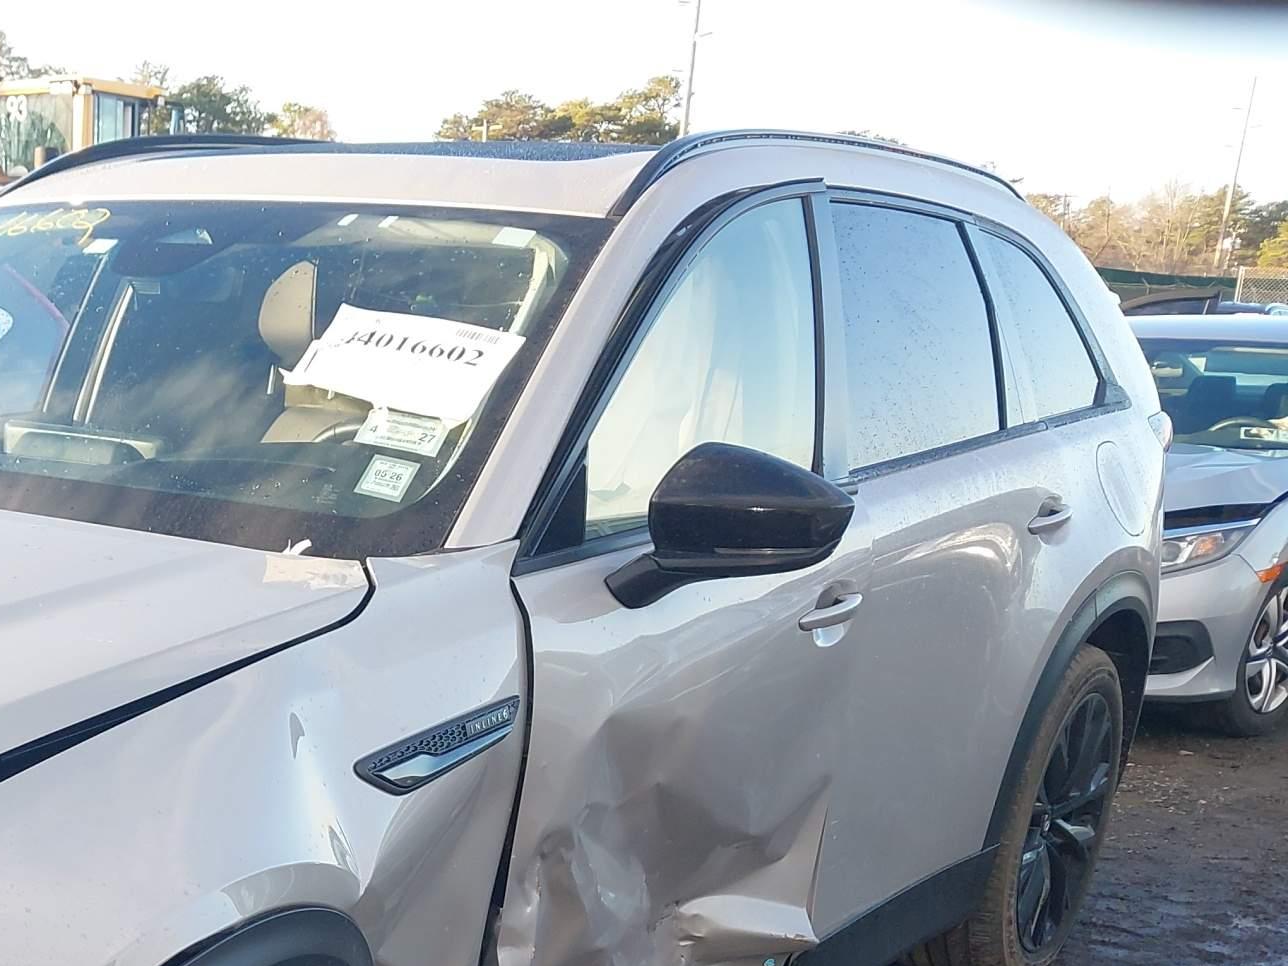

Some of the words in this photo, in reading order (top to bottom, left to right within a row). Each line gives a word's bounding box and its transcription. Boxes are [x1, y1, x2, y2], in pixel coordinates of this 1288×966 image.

[6, 94, 28, 122] 93
[417, 432, 437, 444] 27
[374, 468, 388, 478] 05
[389, 471, 403, 481] 26
